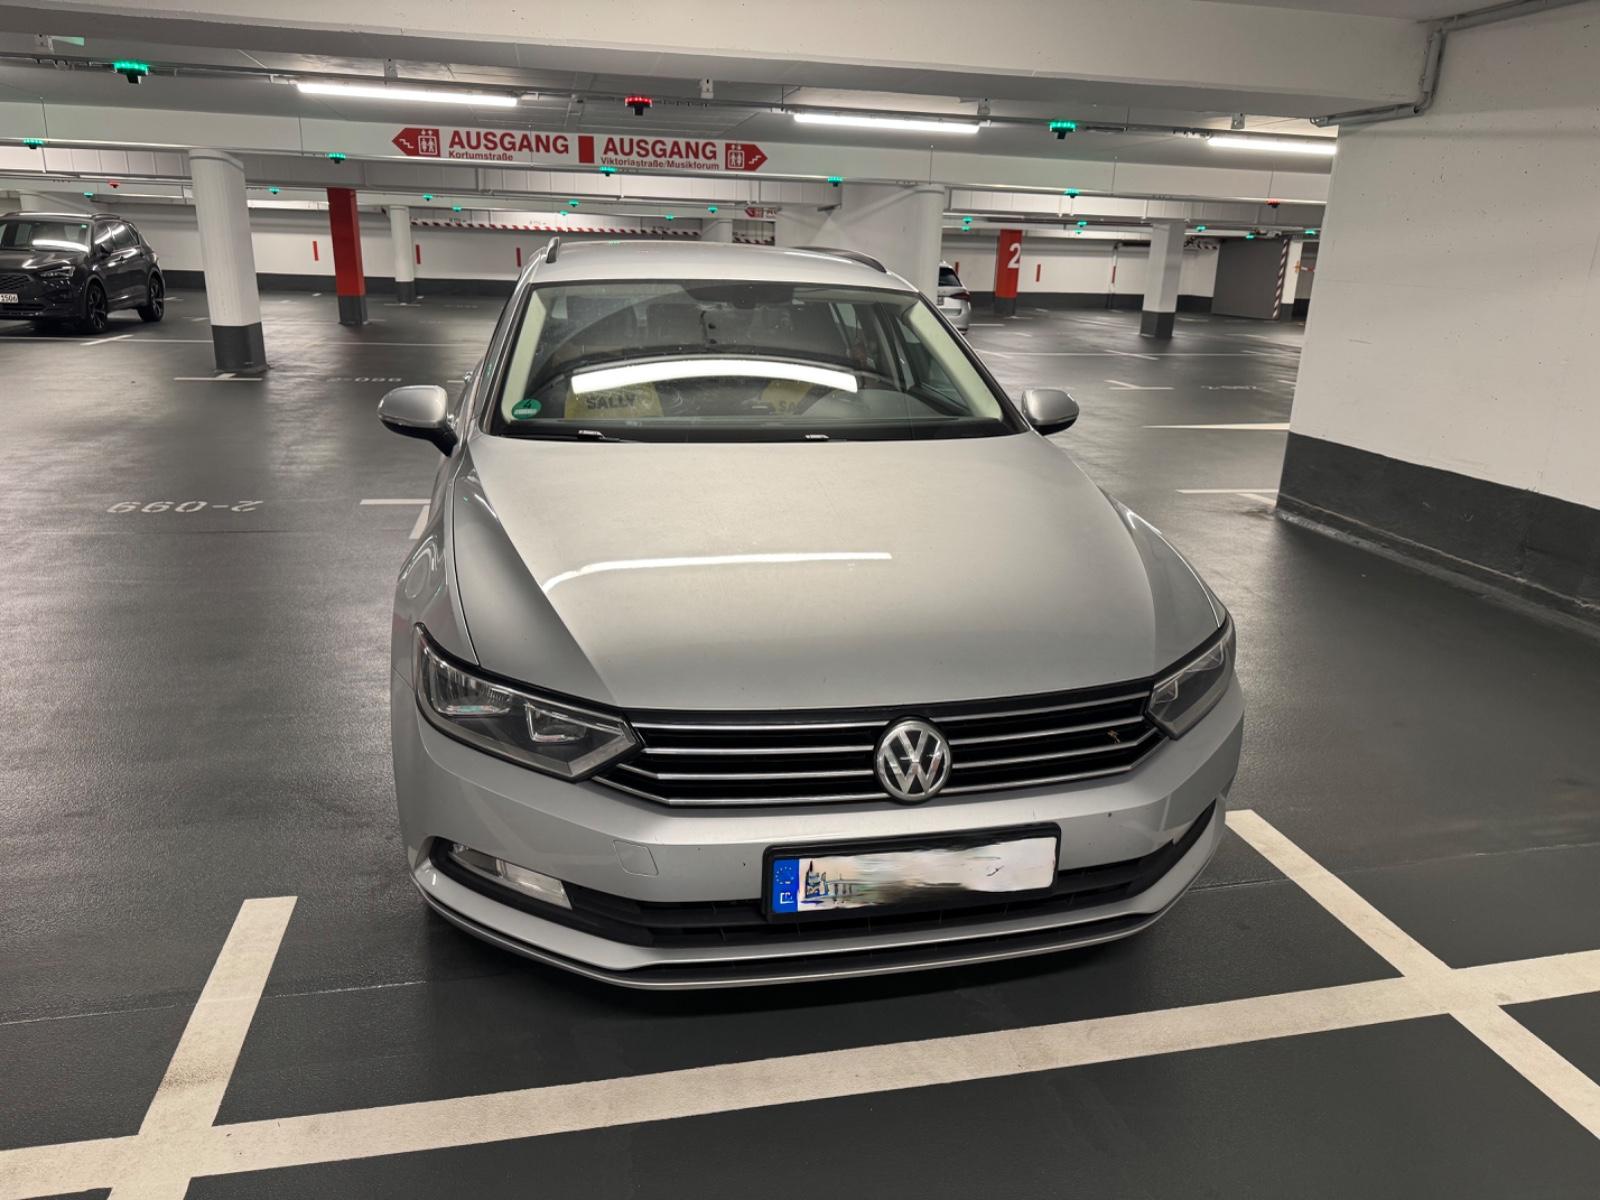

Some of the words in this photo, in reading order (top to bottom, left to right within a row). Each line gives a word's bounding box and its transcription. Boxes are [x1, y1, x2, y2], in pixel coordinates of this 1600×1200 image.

[448, 130, 569, 154] AUSGANG
[603, 137, 717, 160] AUSGANG
[448, 150, 514, 161] Kortumstraße
[600, 157, 719, 170] Viktoriastraße/Musikforum
[1007, 243, 1021, 269] 2
[585, 394, 636, 409] SALLY
[106, 500, 264, 513] 2-099
[879, 724, 948, 796] VW
